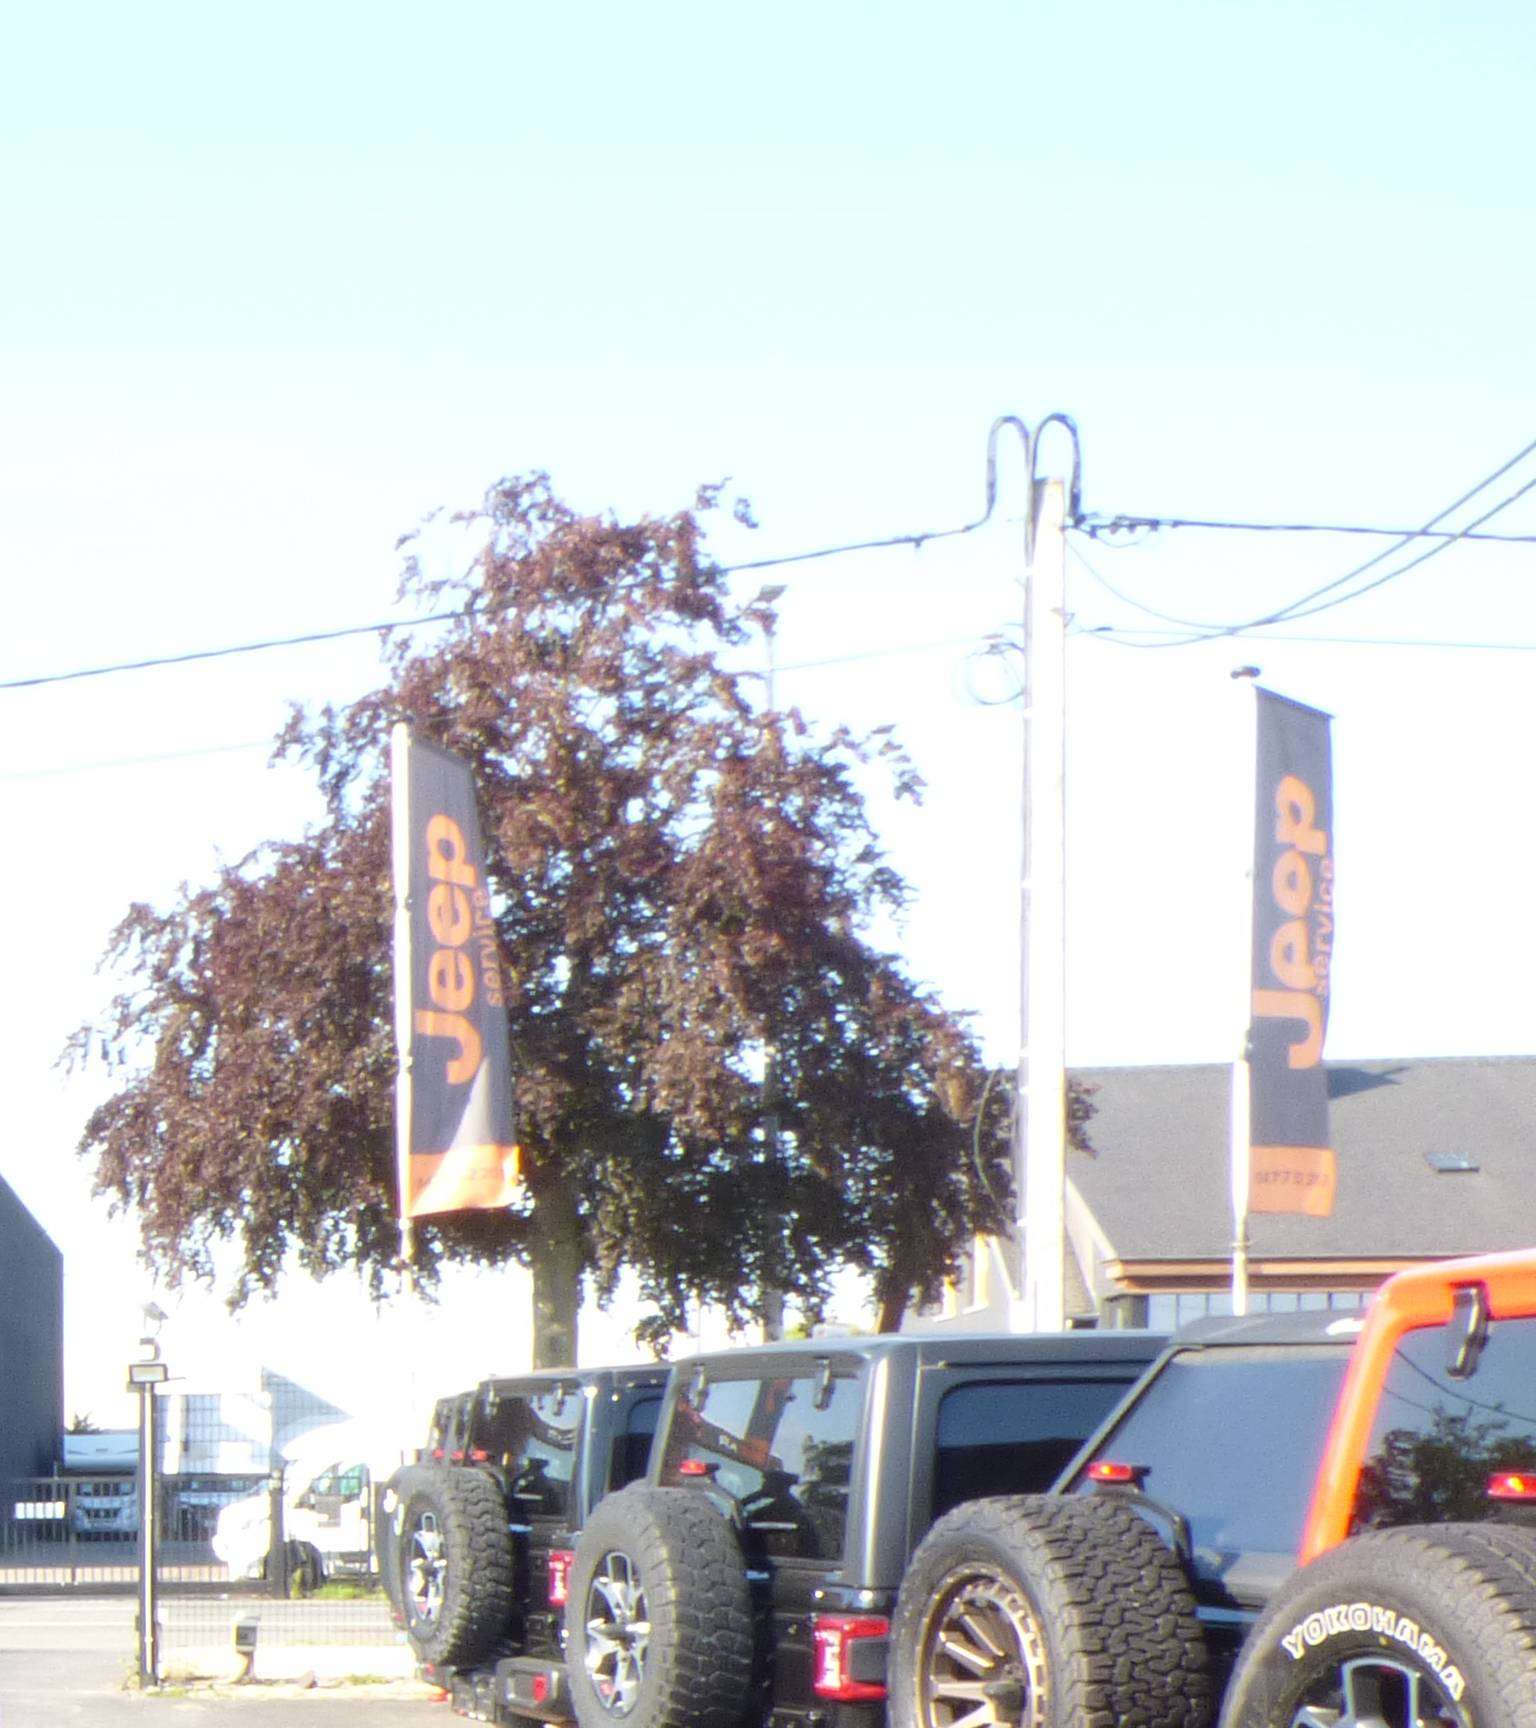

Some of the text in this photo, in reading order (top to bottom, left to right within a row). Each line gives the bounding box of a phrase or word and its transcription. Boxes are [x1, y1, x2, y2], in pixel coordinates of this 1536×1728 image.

[415, 813, 483, 1085] Jeep
[1251, 775, 1327, 1070] Jeep
[1281, 1602, 1466, 1701] YOKOHAMA
